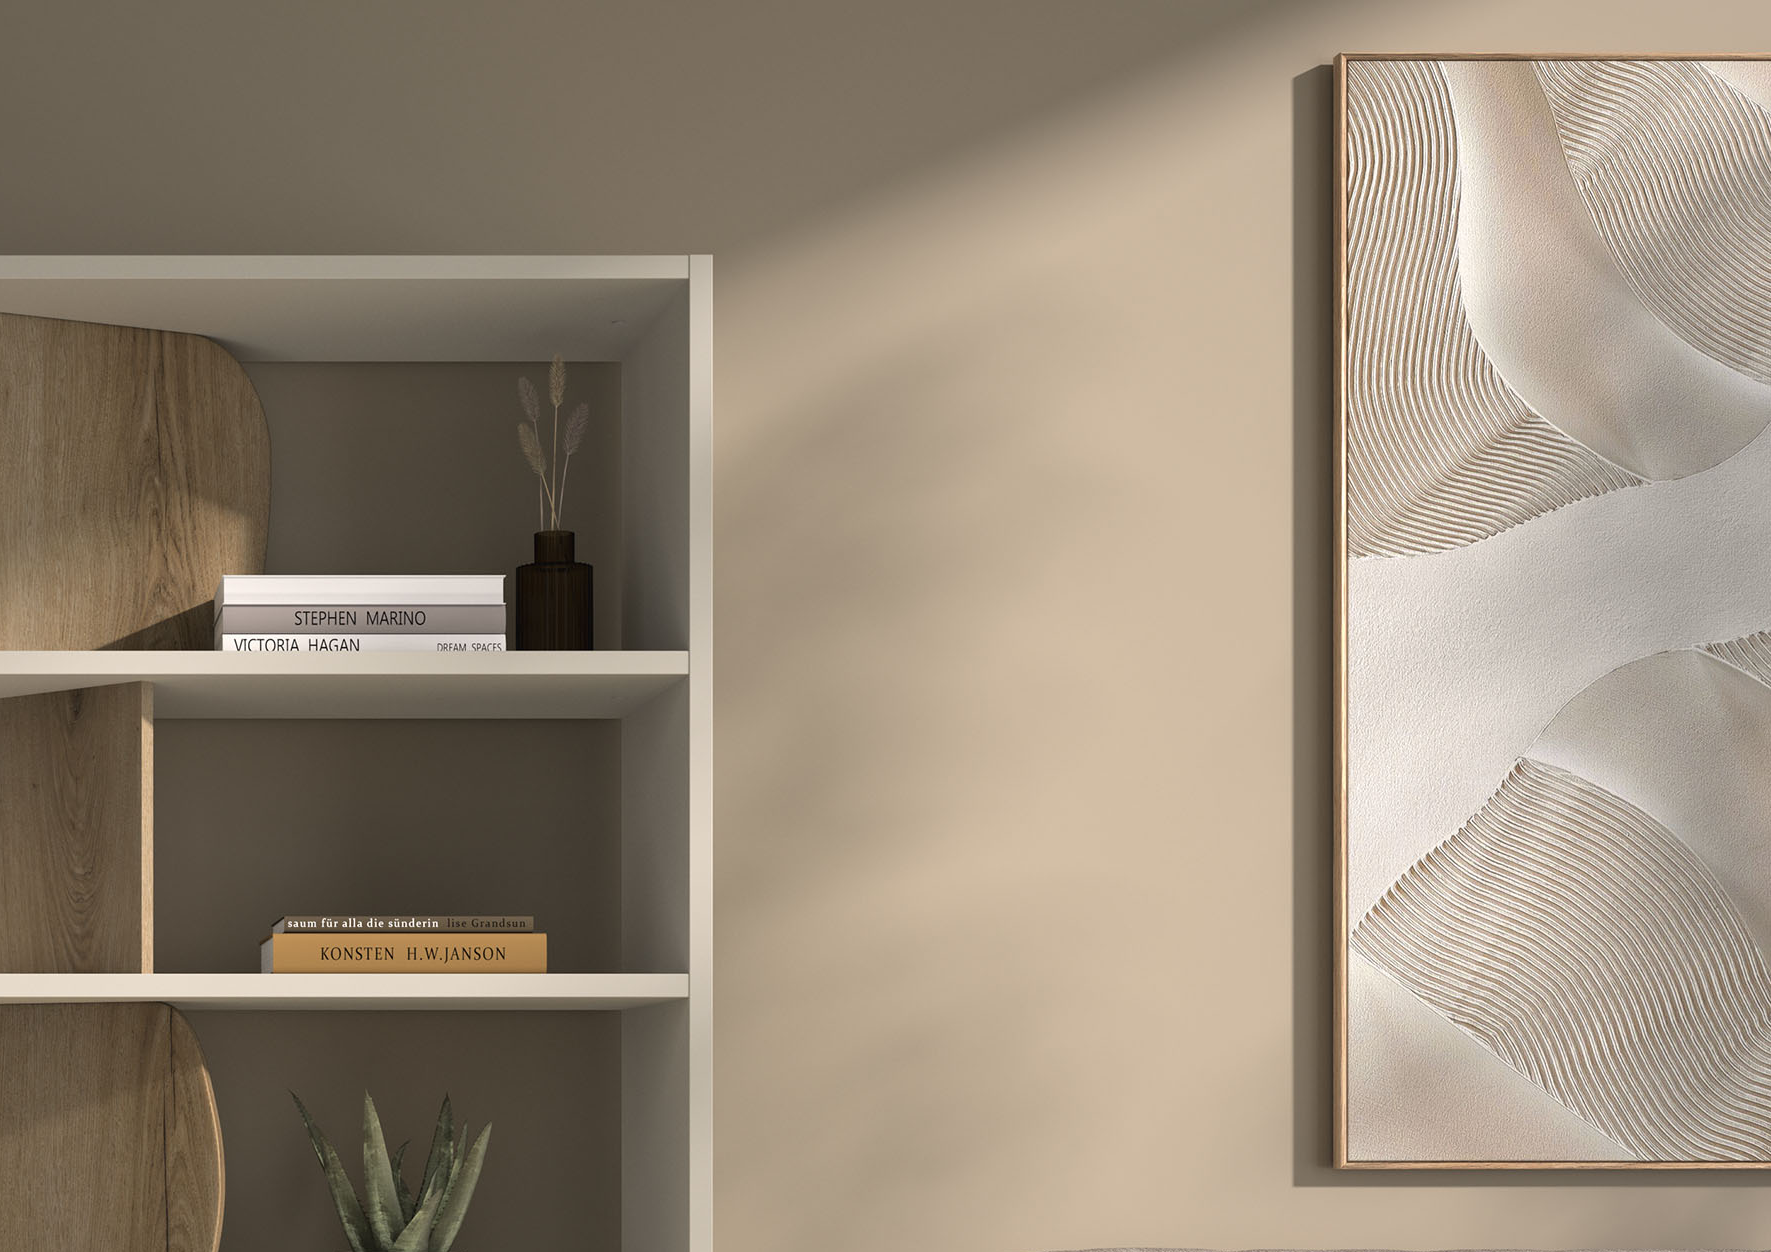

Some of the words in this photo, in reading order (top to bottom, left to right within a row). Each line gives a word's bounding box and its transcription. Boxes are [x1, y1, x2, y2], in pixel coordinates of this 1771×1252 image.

[294, 611, 357, 626] STEPHEN
[366, 611, 426, 626] MARINO
[234, 638, 300, 651] VICTORIA
[309, 638, 360, 651] HAGAN
[436, 643, 467, 651] DREAM
[471, 643, 502, 651] SPACES
[287, 920, 317, 928] saum
[321, 918, 339, 928] für
[342, 918, 363, 928] alla
[366, 918, 384, 928] die
[388, 918, 439, 928] sünderin
[471, 918, 526, 928] Grandsun
[320, 946, 394, 961] KONSTEN
[407, 946, 506, 964] H.W.JANSON
